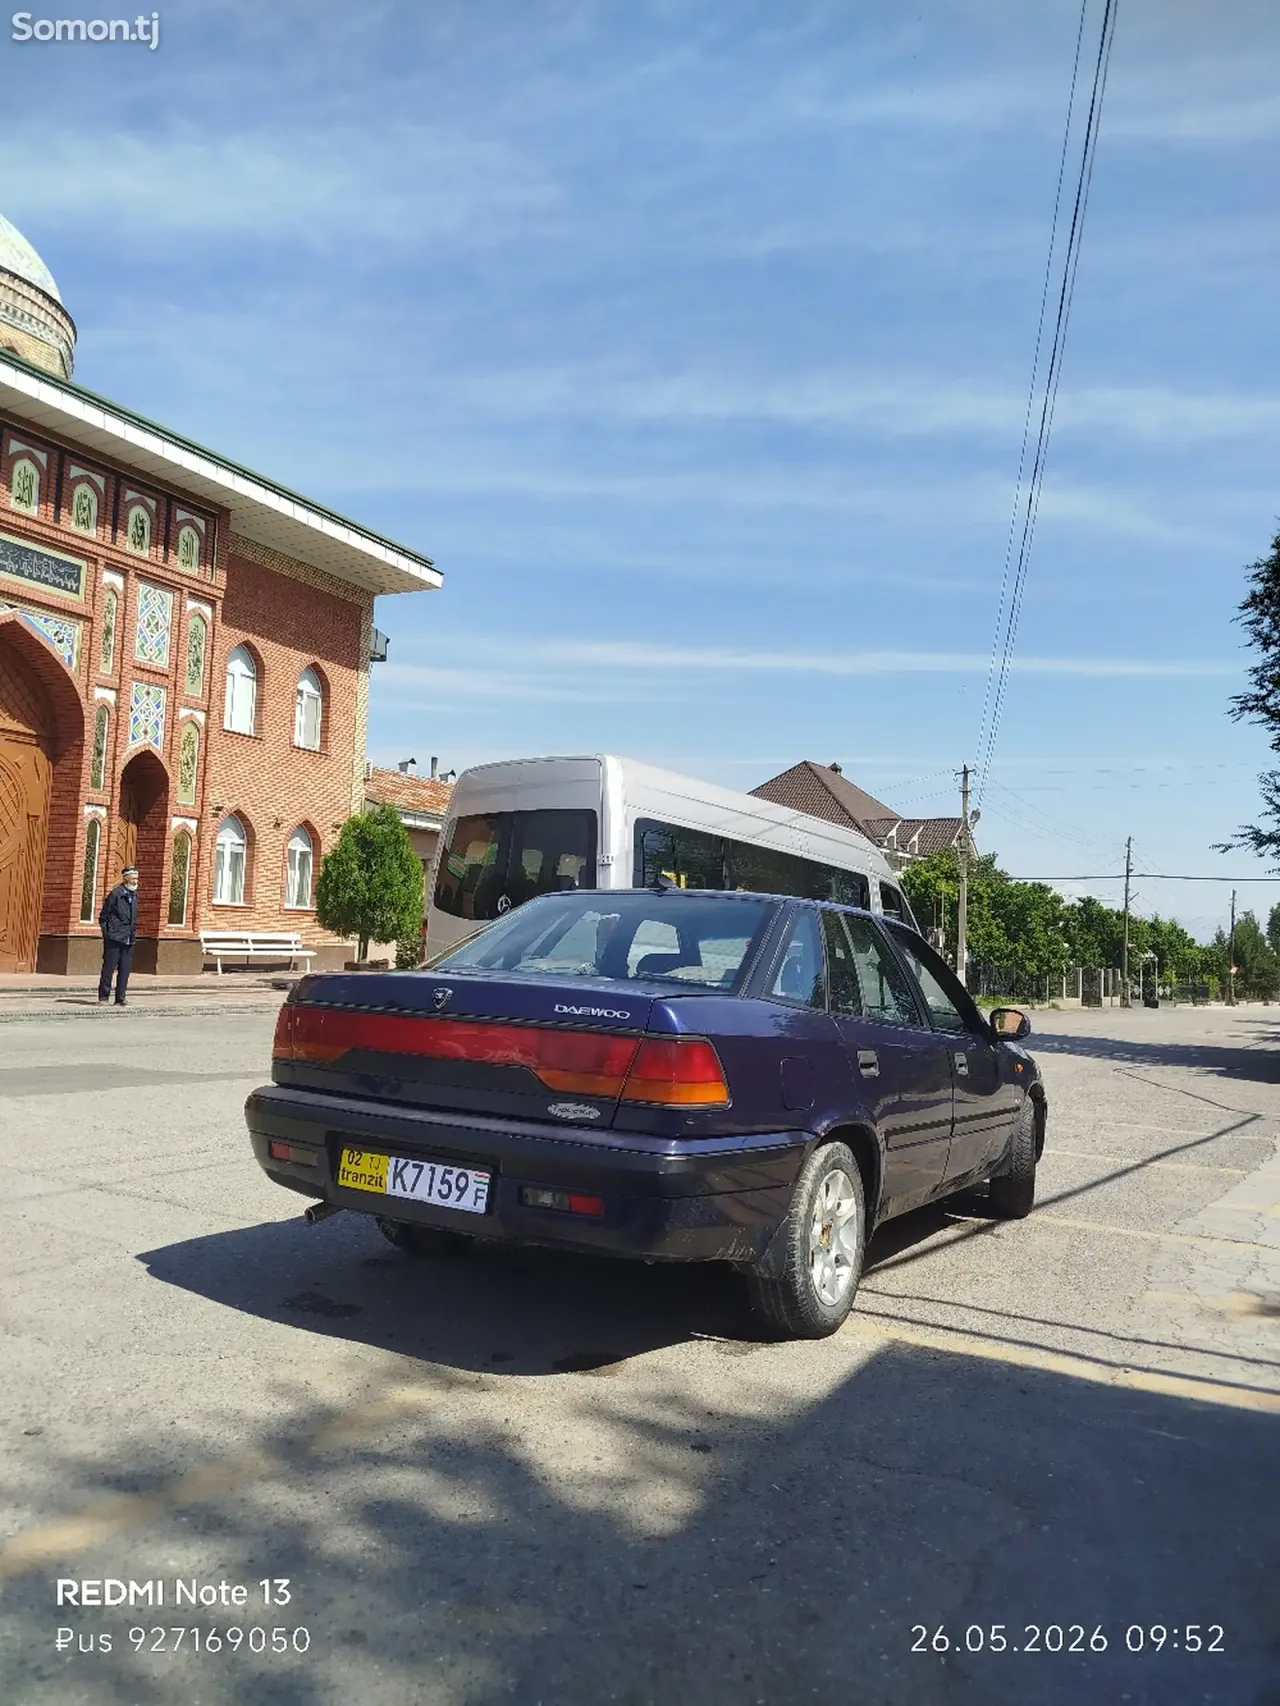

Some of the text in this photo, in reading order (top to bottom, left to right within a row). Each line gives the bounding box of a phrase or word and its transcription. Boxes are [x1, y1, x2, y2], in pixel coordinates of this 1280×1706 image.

[553, 1003, 631, 1020] DAEWOO
[347, 1150, 363, 1166] 02
[340, 1166, 384, 1188] tranzit
[391, 1158, 470, 1203] K7159
